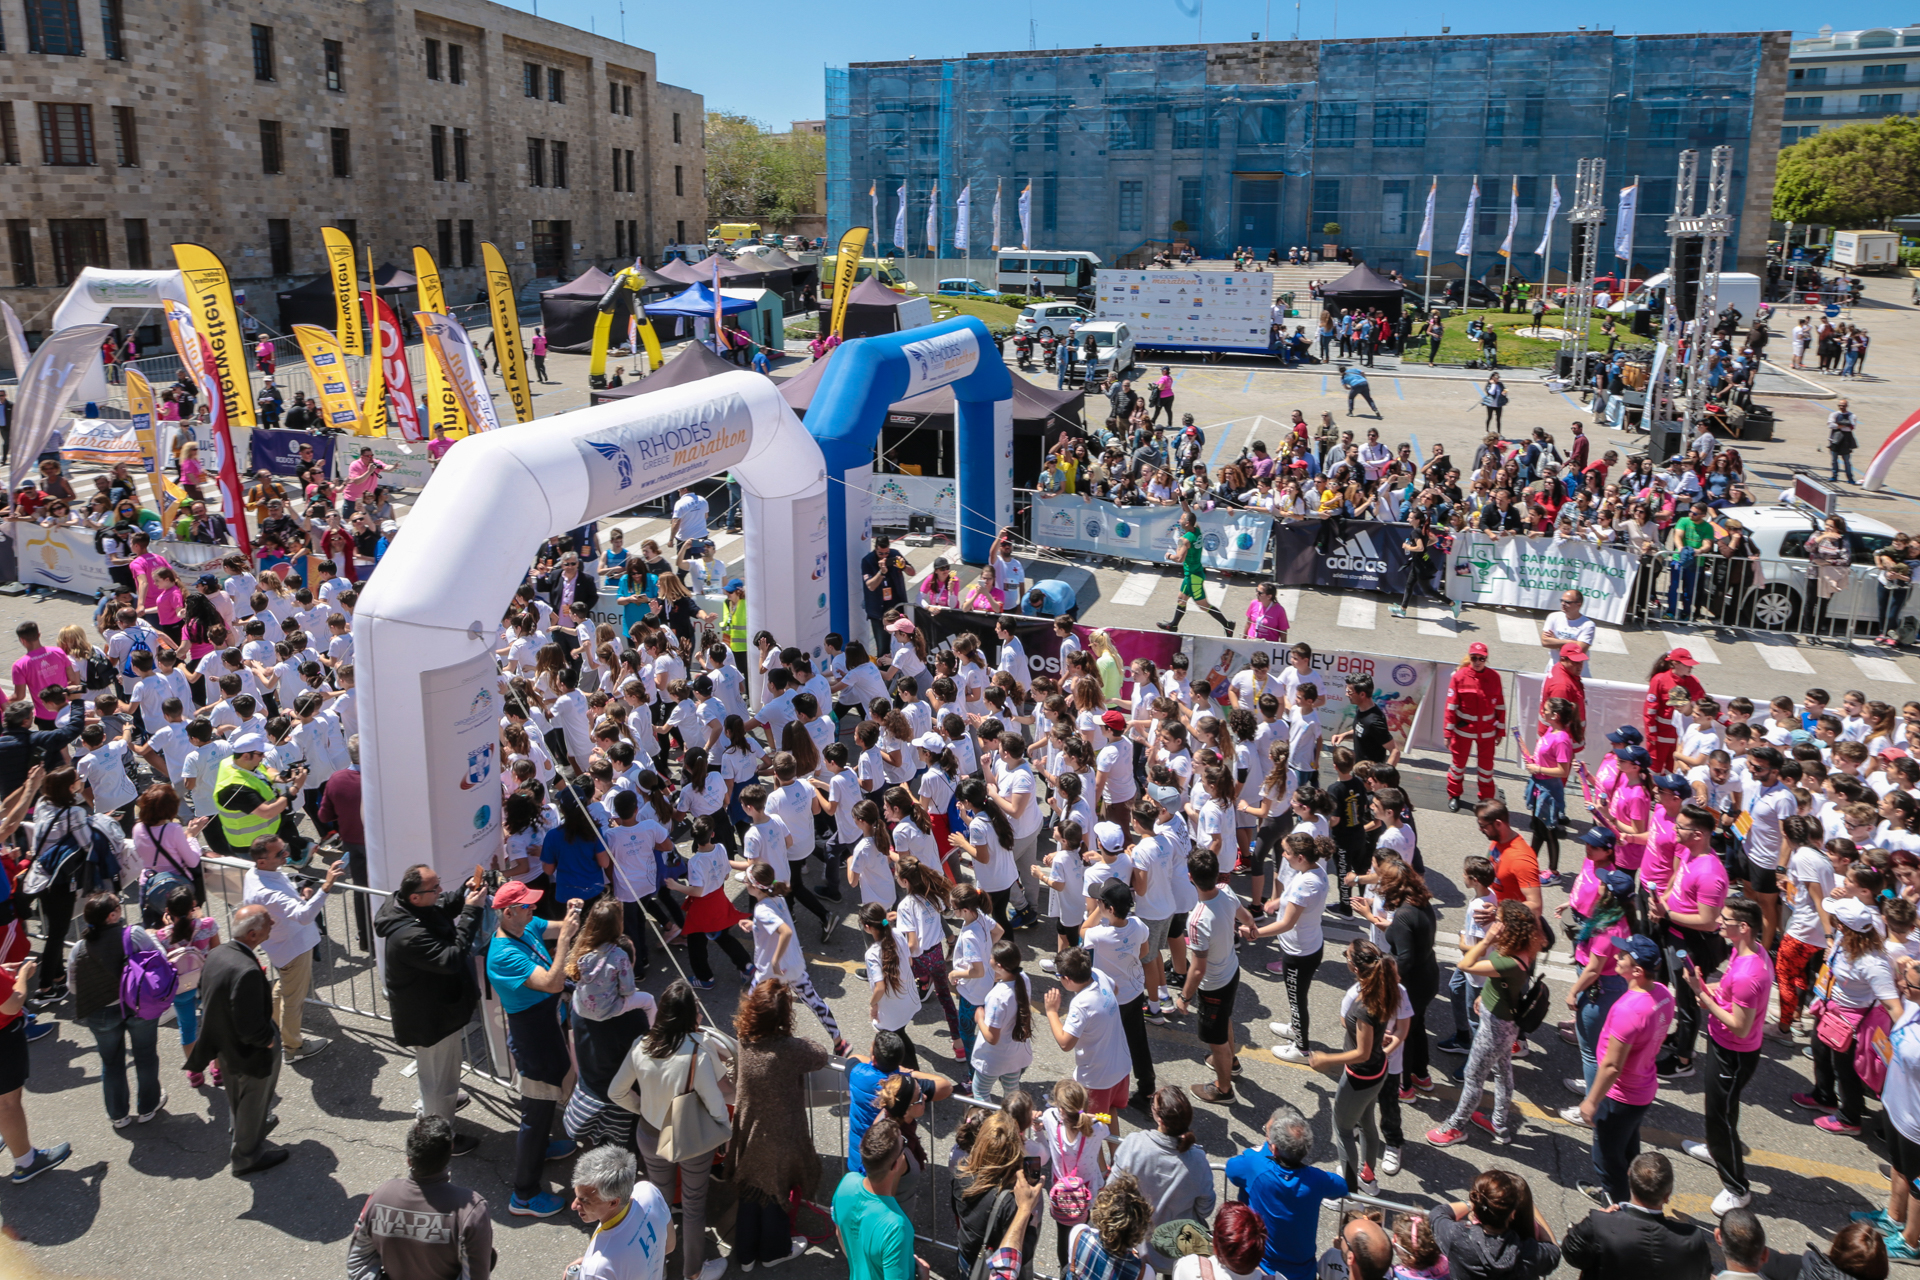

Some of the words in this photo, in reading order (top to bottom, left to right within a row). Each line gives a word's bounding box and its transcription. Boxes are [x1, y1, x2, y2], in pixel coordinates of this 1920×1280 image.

[1152, 276, 1197, 286] marathon
[928, 343, 962, 365] RHODES
[637, 420, 712, 460] RHODES
[642, 454, 671, 471] GREECE
[672, 427, 748, 467] marathon
[1325, 554, 1388, 574] adidas
[1518, 565, 1580, 582] ΣΥΛΛΟΓΟΣ
[1519, 552, 1627, 579] ΦΑΡΜΑΚΕΥΤΙΚΟΣ
[1337, 656, 1375, 677] BAR
[468, 742, 491, 757] SEGAS
[374, 1206, 447, 1241] NAPA
